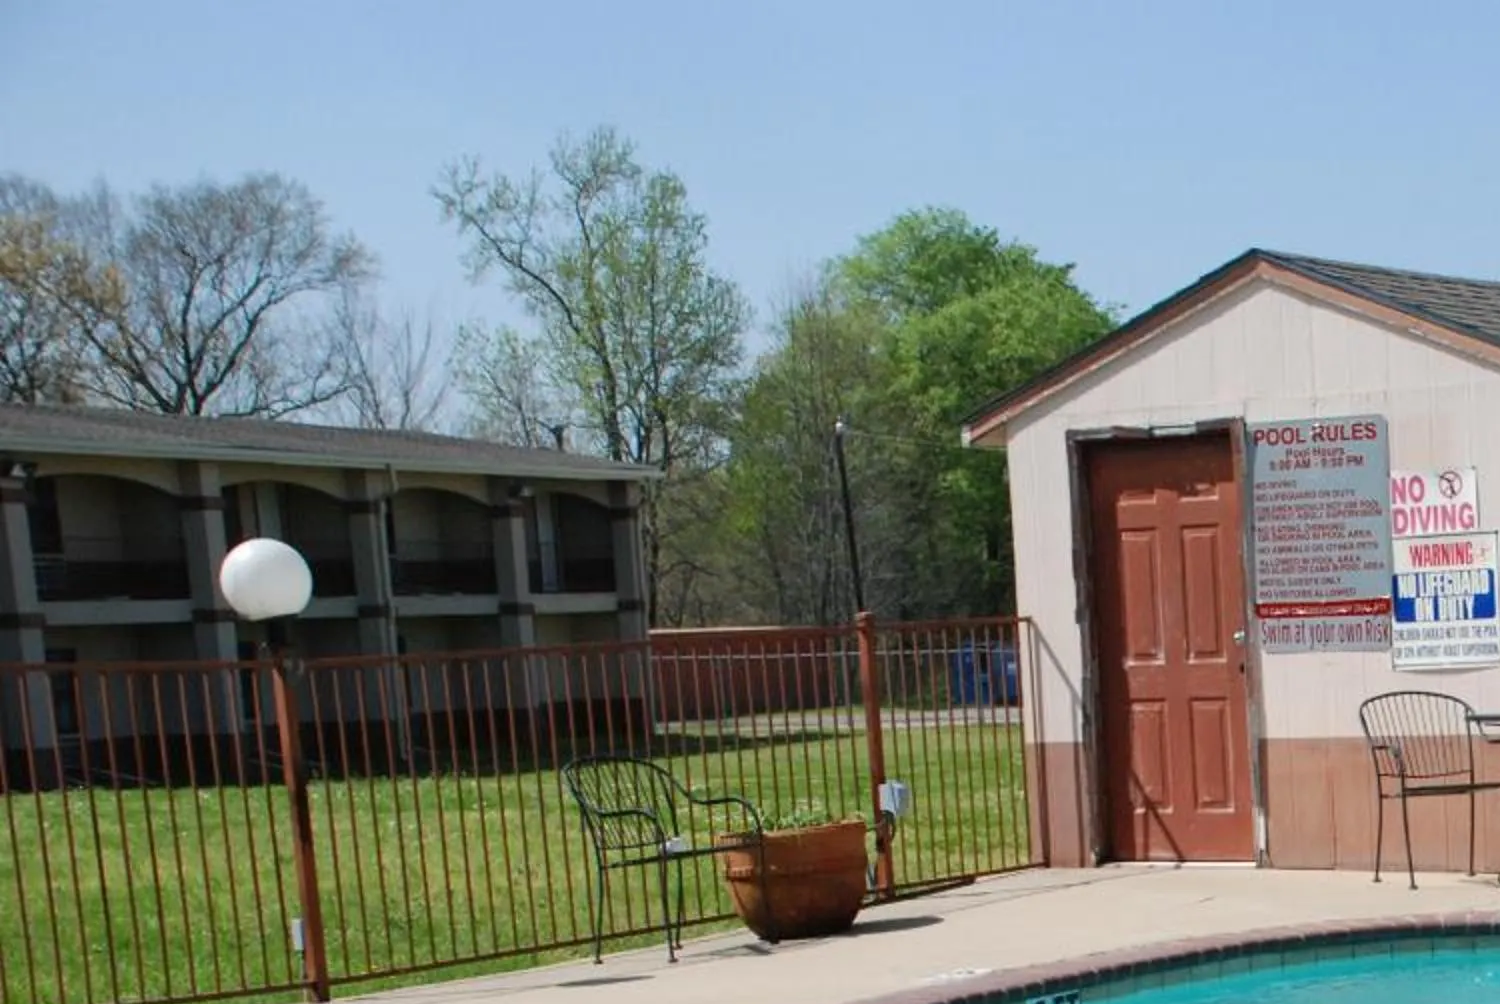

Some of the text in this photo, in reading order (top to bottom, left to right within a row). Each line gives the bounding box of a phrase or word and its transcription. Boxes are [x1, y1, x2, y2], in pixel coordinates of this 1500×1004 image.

[1252, 422, 1377, 447] POOL RULES
[1347, 455, 1362, 466] PM
[1392, 475, 1424, 504] NO
[1392, 502, 1475, 535] DIVING
[1408, 541, 1473, 568] WARNING
[1262, 618, 1389, 650] Swim at your own Risk
